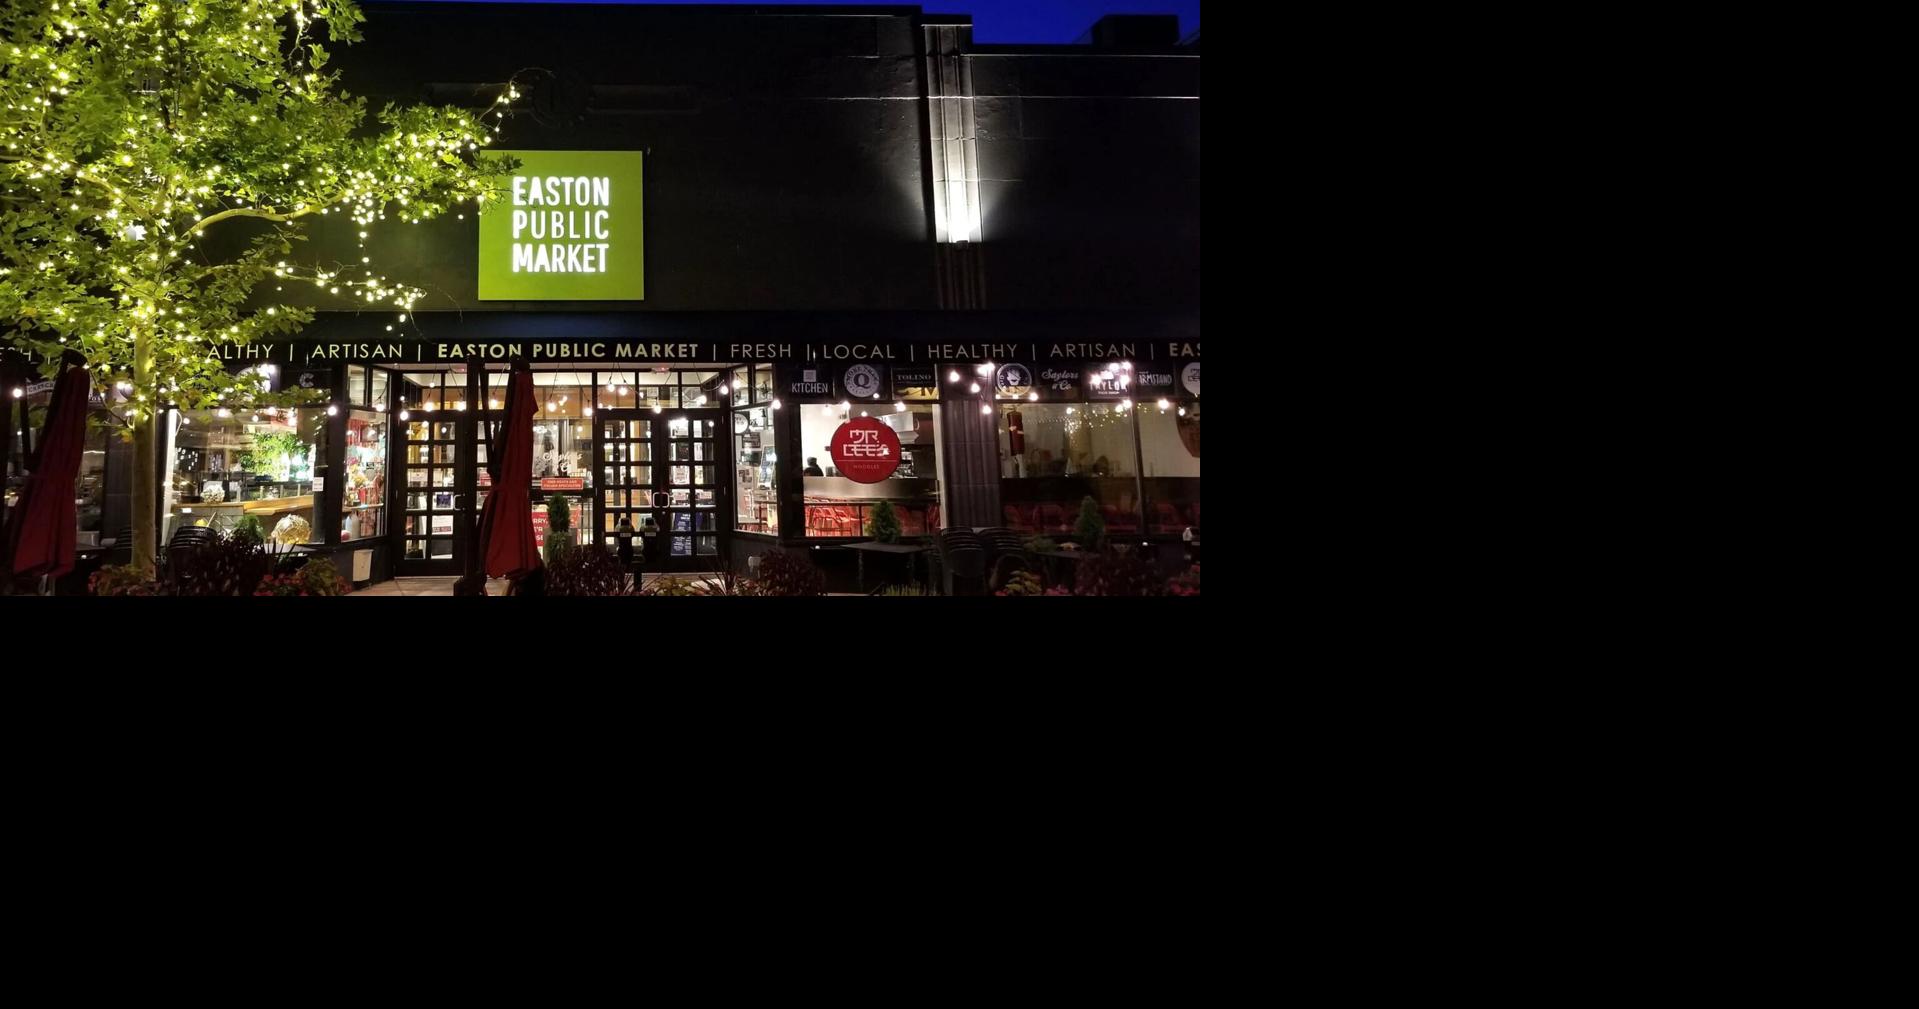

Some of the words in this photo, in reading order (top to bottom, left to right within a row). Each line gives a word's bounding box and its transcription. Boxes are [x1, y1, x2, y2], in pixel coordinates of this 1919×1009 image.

[512, 176, 610, 207] EASTON
[512, 209, 610, 240] PUBLIC
[512, 243, 610, 273] MARKET
[207, 344, 274, 359] ALTHY
[311, 344, 402, 359] ARTISAN
[438, 343, 521, 359] EASTON
[533, 343, 606, 359] PUBLIC
[615, 343, 698, 359] MARKET
[731, 344, 791, 359] FRESH
[823, 344, 896, 359] LOCAL
[928, 344, 1017, 359] HEALTHY
[1050, 343, 1136, 358] ARTISAN
[791, 382, 828, 394] KITCHEN
